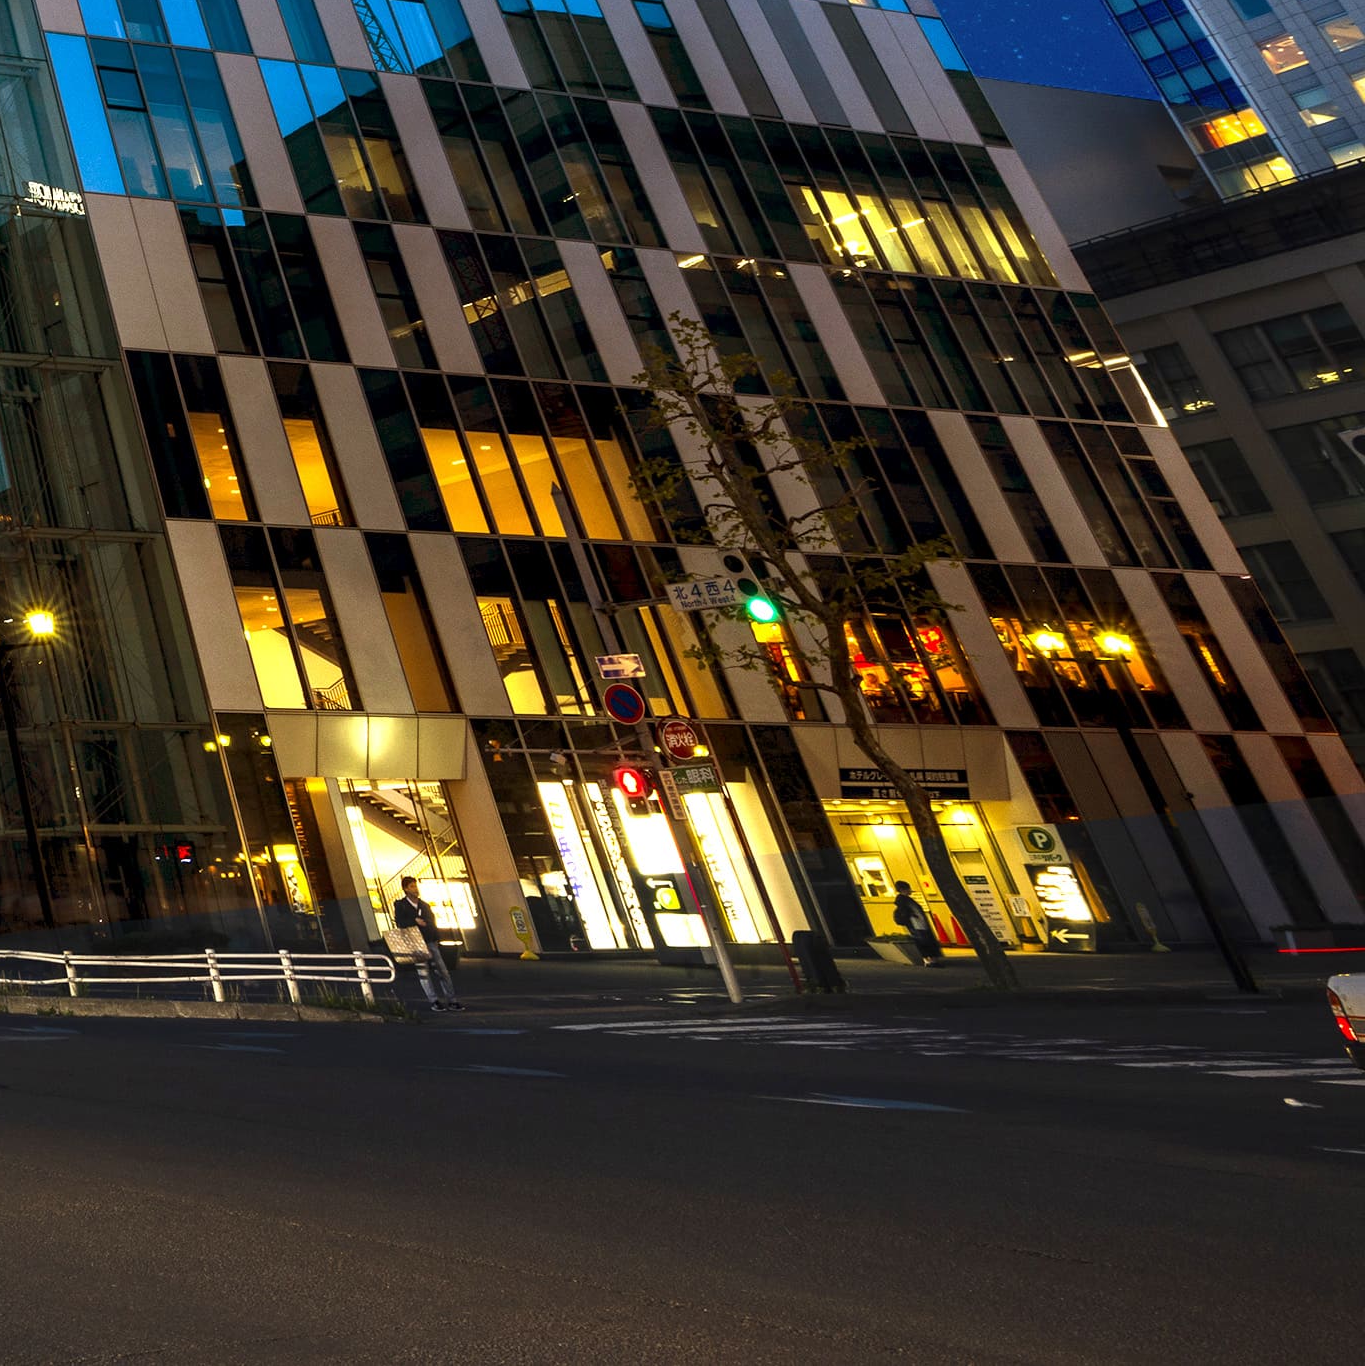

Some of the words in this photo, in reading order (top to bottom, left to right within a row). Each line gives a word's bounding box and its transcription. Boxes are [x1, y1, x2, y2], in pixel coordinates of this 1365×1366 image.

[673, 579, 736, 600] 北4西4
[666, 731, 695, 748] 消火栓
[1032, 832, 1048, 849] P
